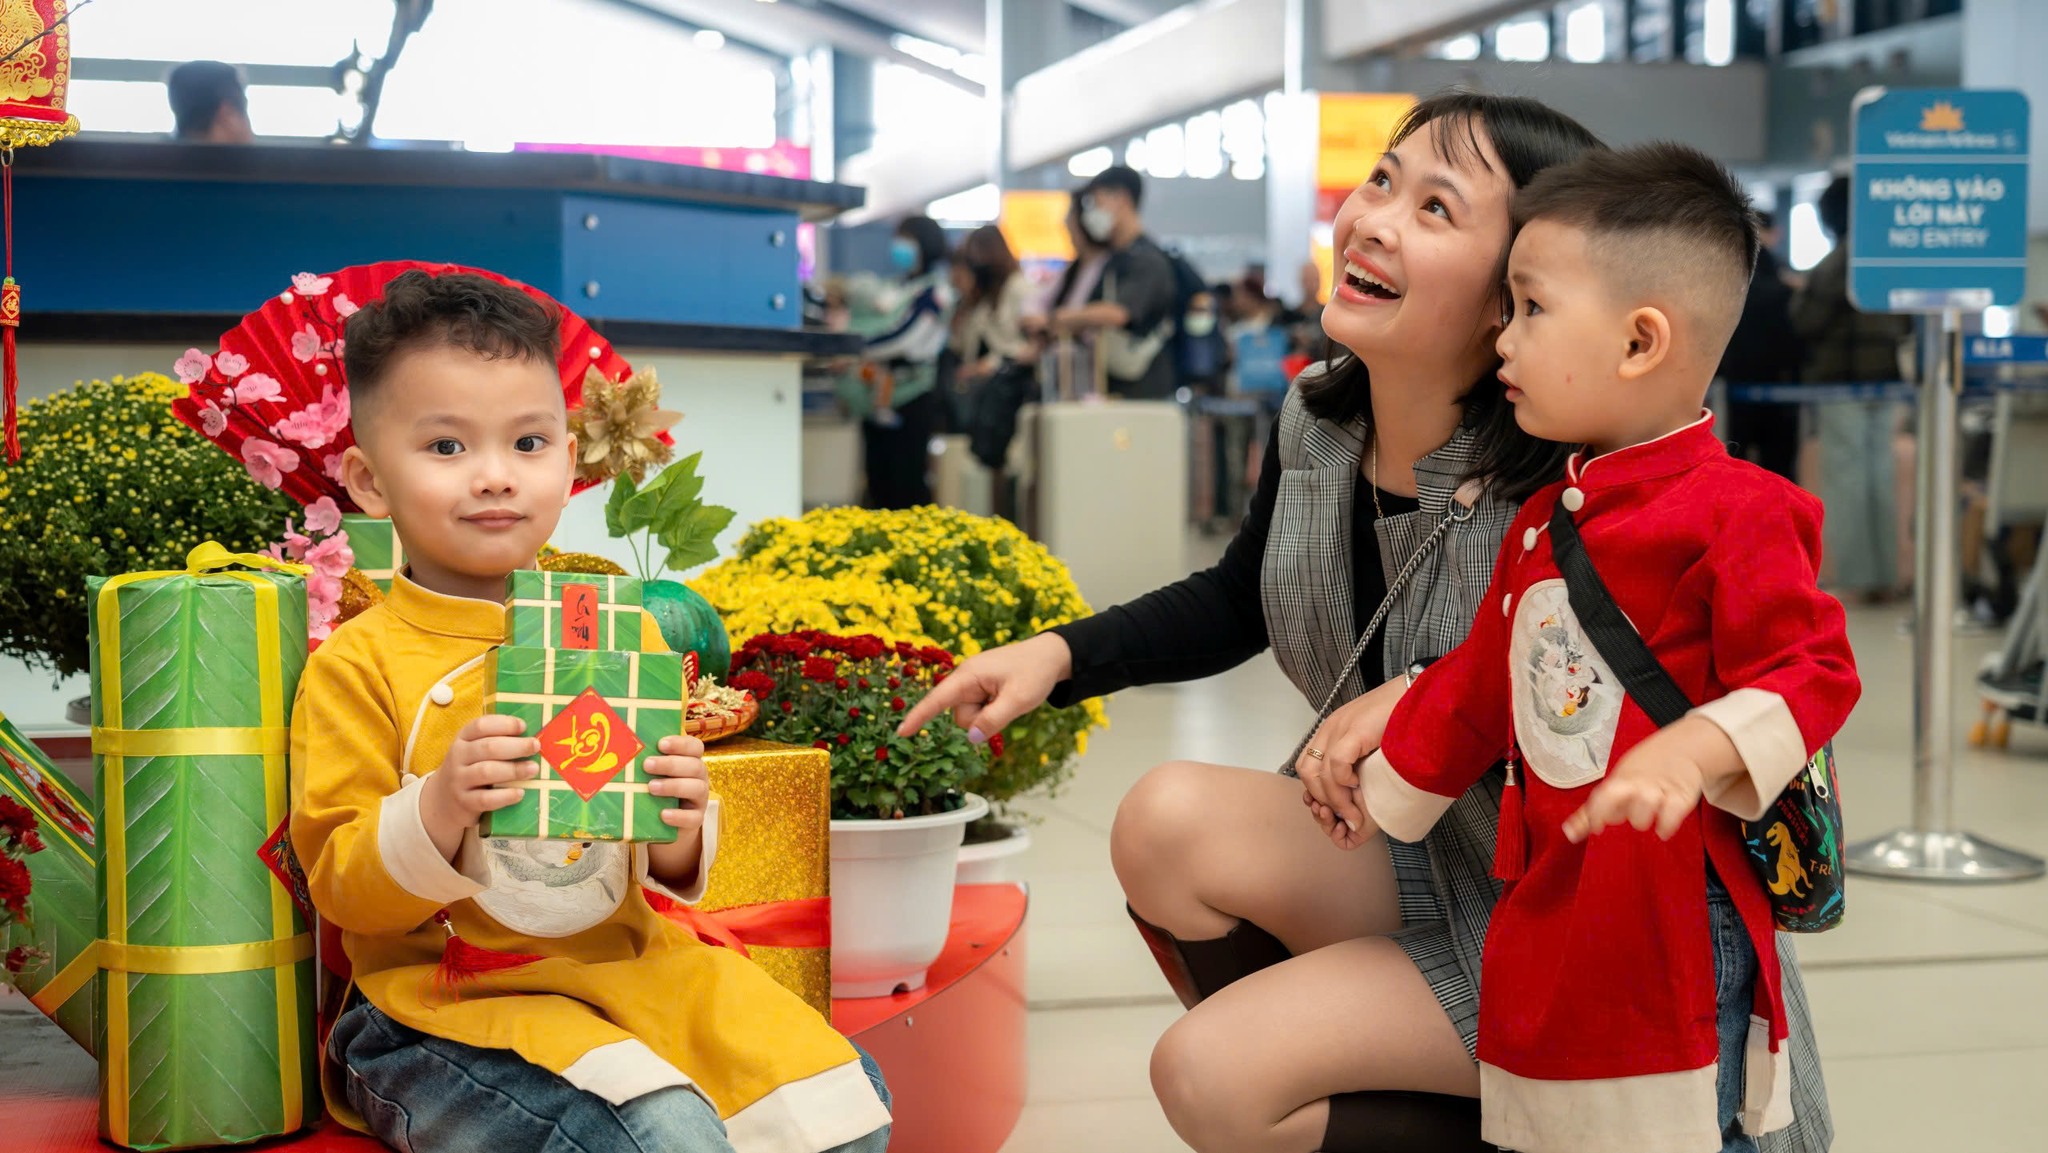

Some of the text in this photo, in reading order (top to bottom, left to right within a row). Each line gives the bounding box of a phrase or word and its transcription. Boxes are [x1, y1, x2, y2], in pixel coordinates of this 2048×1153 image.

[1870, 174, 2005, 201] KHÔNG VÀO
[1888, 227, 1989, 249] NO ENTRY
